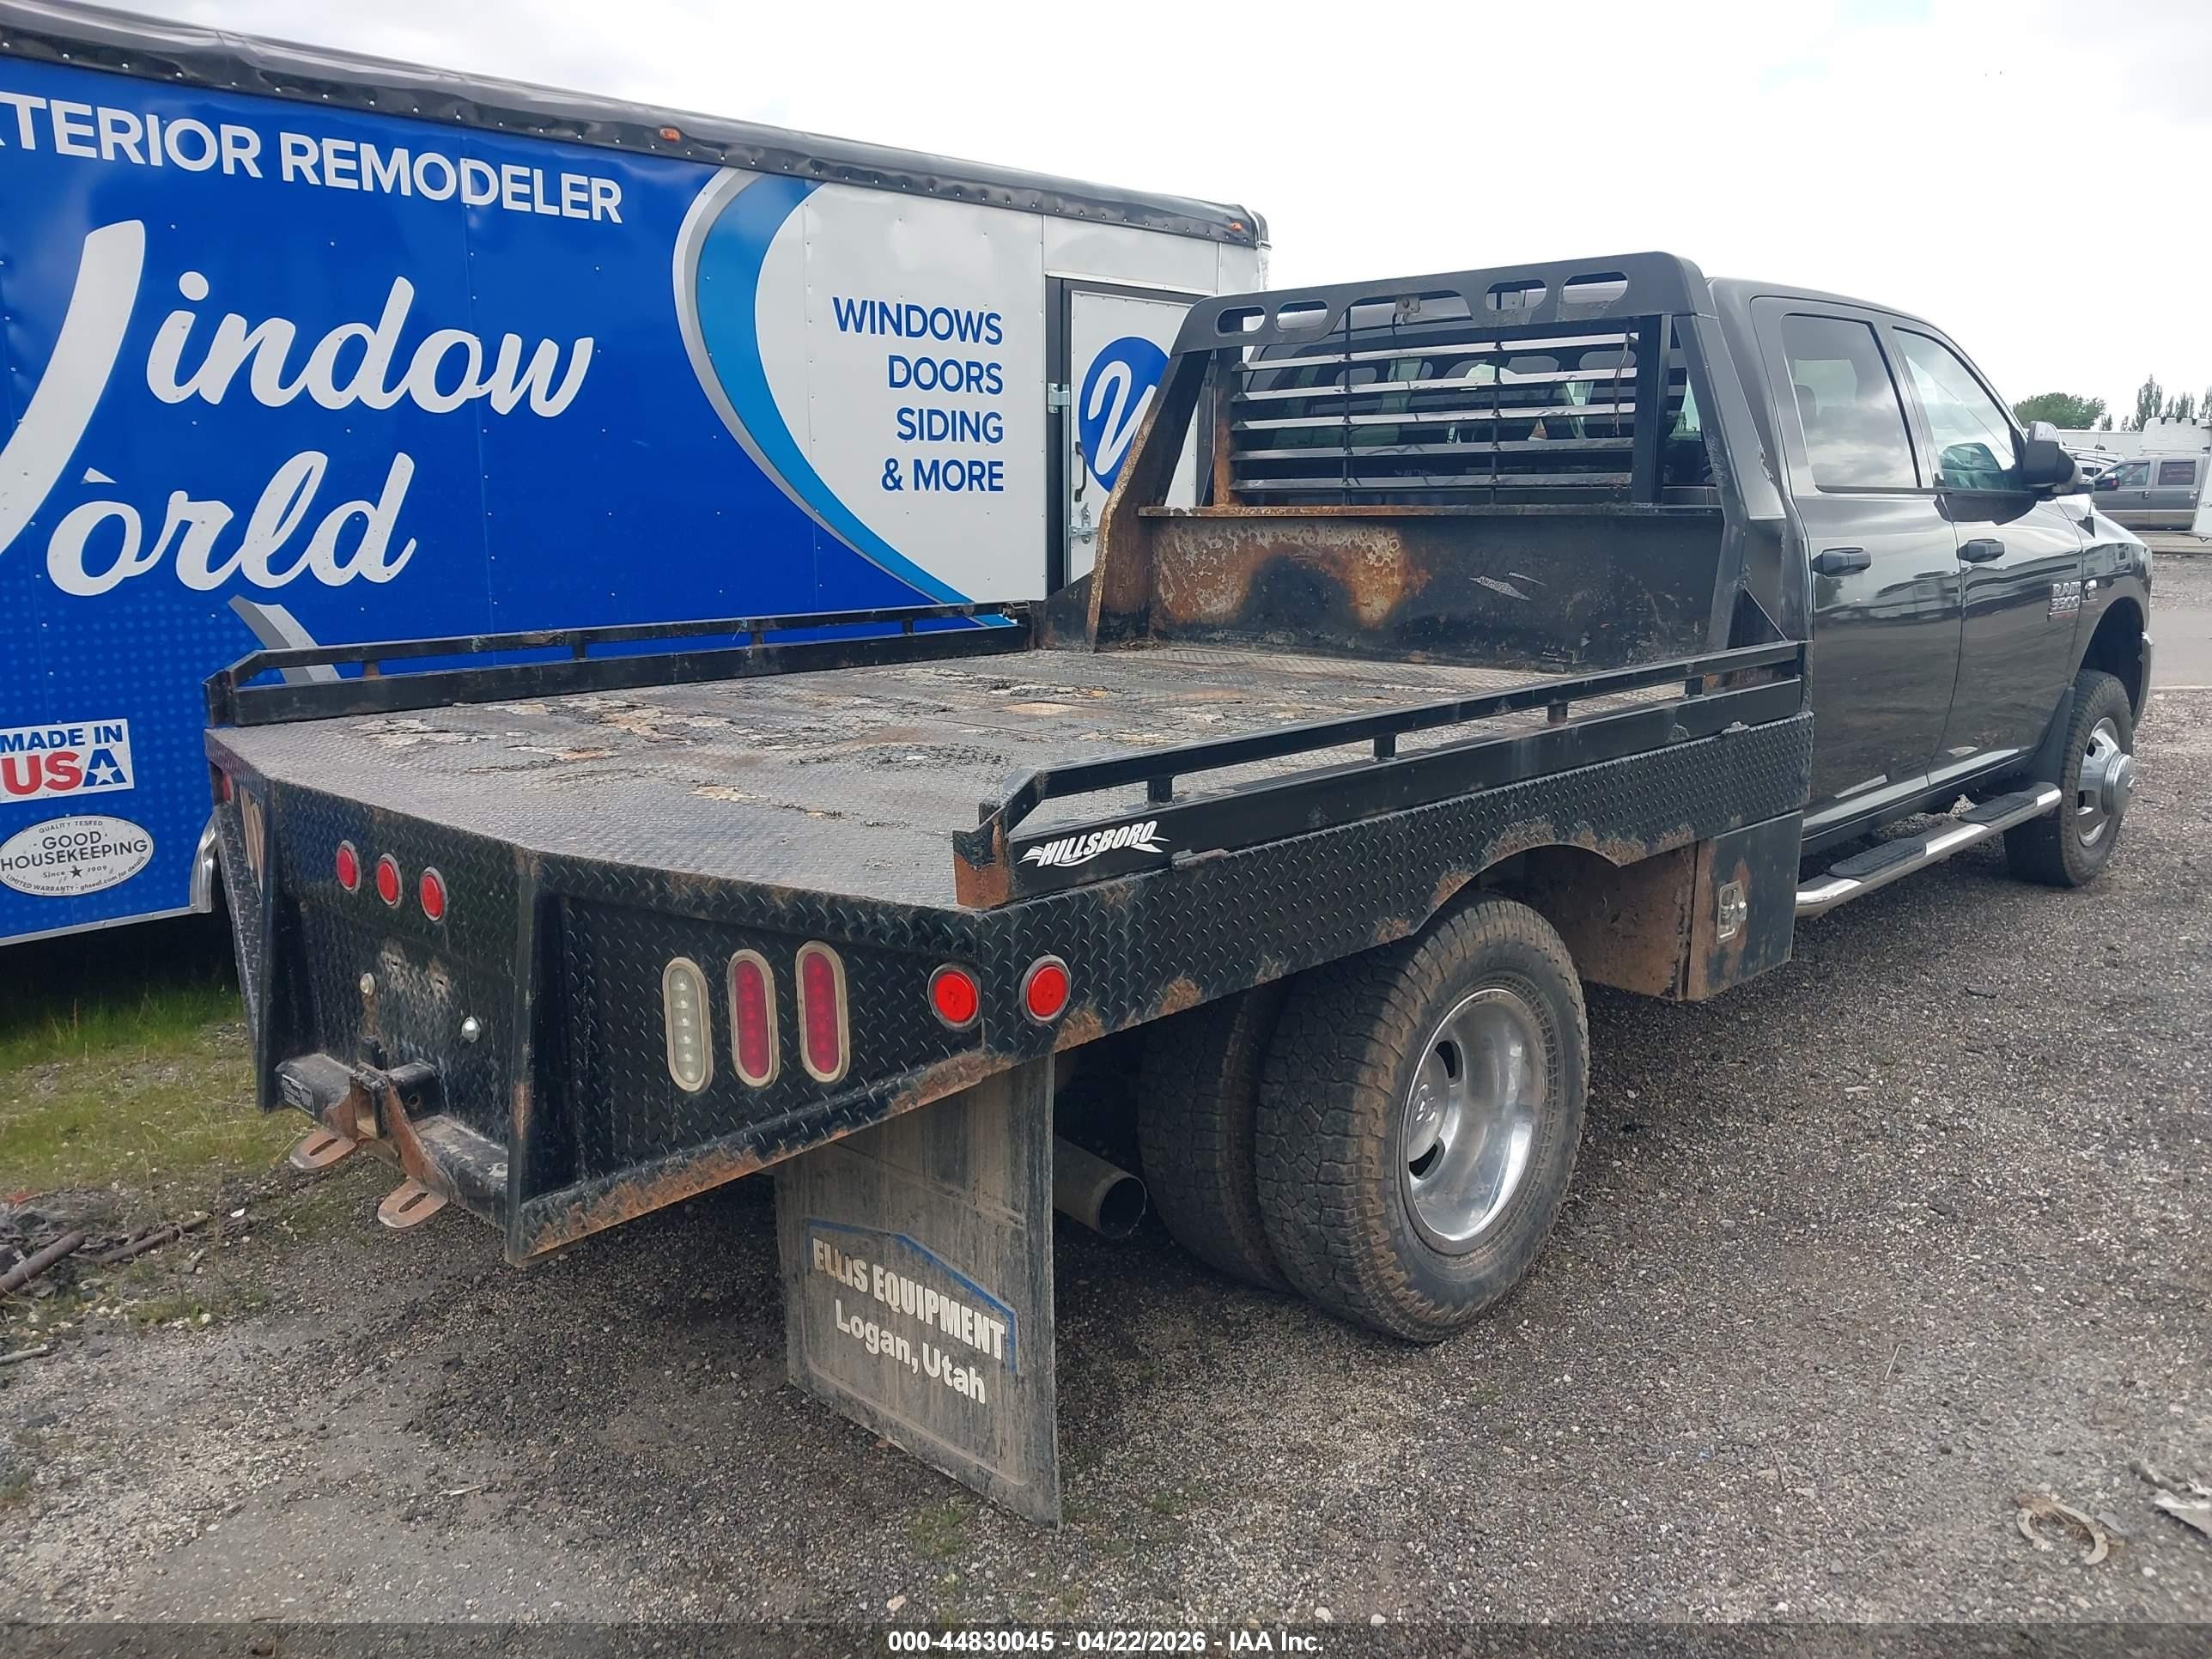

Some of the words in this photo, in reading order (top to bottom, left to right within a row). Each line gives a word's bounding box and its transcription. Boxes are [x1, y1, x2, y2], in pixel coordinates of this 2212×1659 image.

[0, 91, 264, 178] TERIOR
[280, 131, 623, 223] REMODELER
[832, 296, 1003, 345] WINDOWS
[888, 355, 1003, 395] DOORS
[896, 407, 1003, 443] SIDING
[881, 458, 902, 492] &
[914, 459, 1004, 492] MORE
[2052, 581, 2081, 597] RAM
[1, 728, 85, 753] MADE
[94, 725, 123, 744] IN
[1, 748, 127, 795] USA
[39, 822, 71, 834] QUALITY
[42, 831, 102, 850] GOOD
[1037, 821, 1158, 867] HILLSBORO
[1, 839, 148, 872] HOUSEKEEPING
[6, 874, 32, 889] LIMITED
[812, 1237, 868, 1293] ELLIS
[872, 1263, 1006, 1361] EQUIPMENT
[835, 1299, 919, 1374] Logan,
[922, 1342, 986, 1405] Utah
